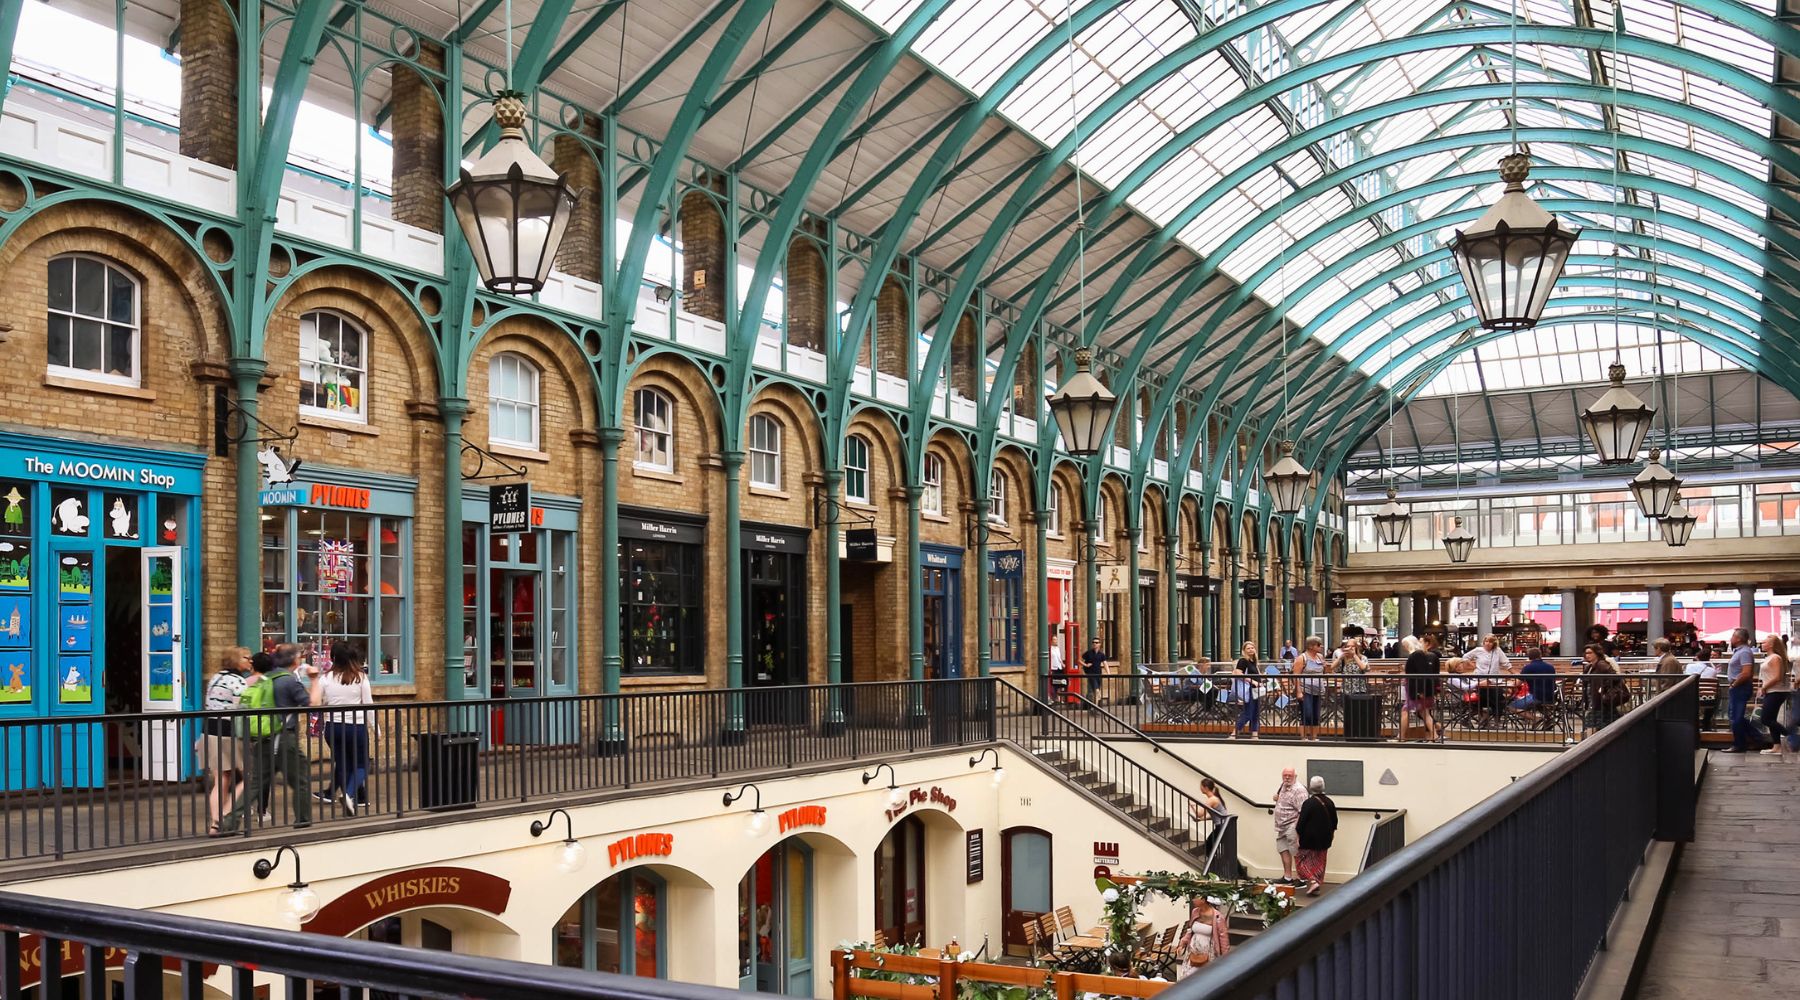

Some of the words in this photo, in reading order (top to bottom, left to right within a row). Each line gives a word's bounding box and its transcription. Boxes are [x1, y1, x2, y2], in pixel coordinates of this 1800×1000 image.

[25, 456, 54, 474] The
[58, 460, 135, 482] MOOMIN
[140, 468, 175, 489] Shop
[262, 490, 297, 505] MOOMIN
[311, 484, 371, 509] PYLONES
[492, 511, 526, 525] PYLONES
[641, 522, 659, 532] Miller
[659, 524, 677, 534] Harris
[926, 553, 947, 565] Whittard
[909, 787, 928, 806] Pie
[930, 786, 957, 812] Shop
[778, 805, 827, 834] PYLONES
[607, 833, 673, 867] PYLONES
[364, 876, 461, 910] WHISKIES
